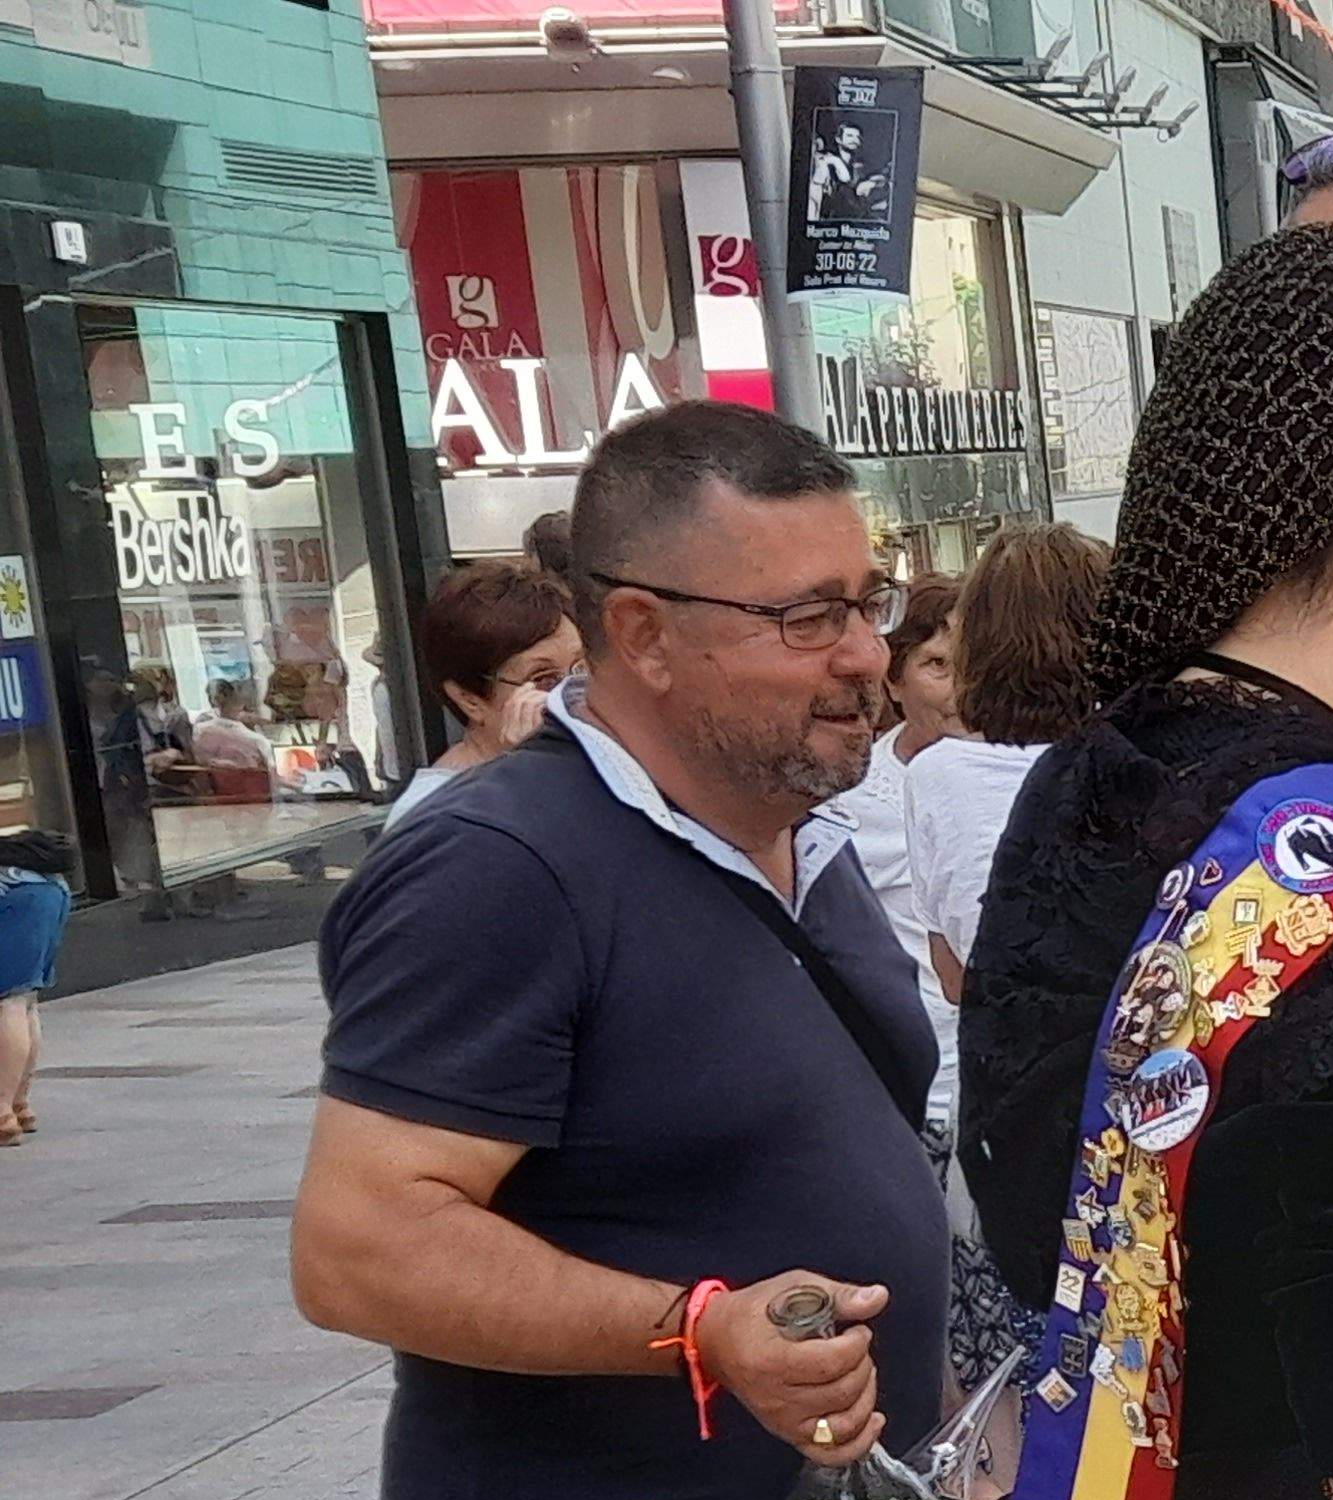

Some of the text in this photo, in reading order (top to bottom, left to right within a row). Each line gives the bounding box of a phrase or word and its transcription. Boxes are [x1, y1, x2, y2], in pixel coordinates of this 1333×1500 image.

[815, 251, 877, 272] 30-06-22
[426, 328, 530, 362] GALA
[875, 386, 1028, 452] PERFUMERIES
[112, 493, 251, 589] Bershka
